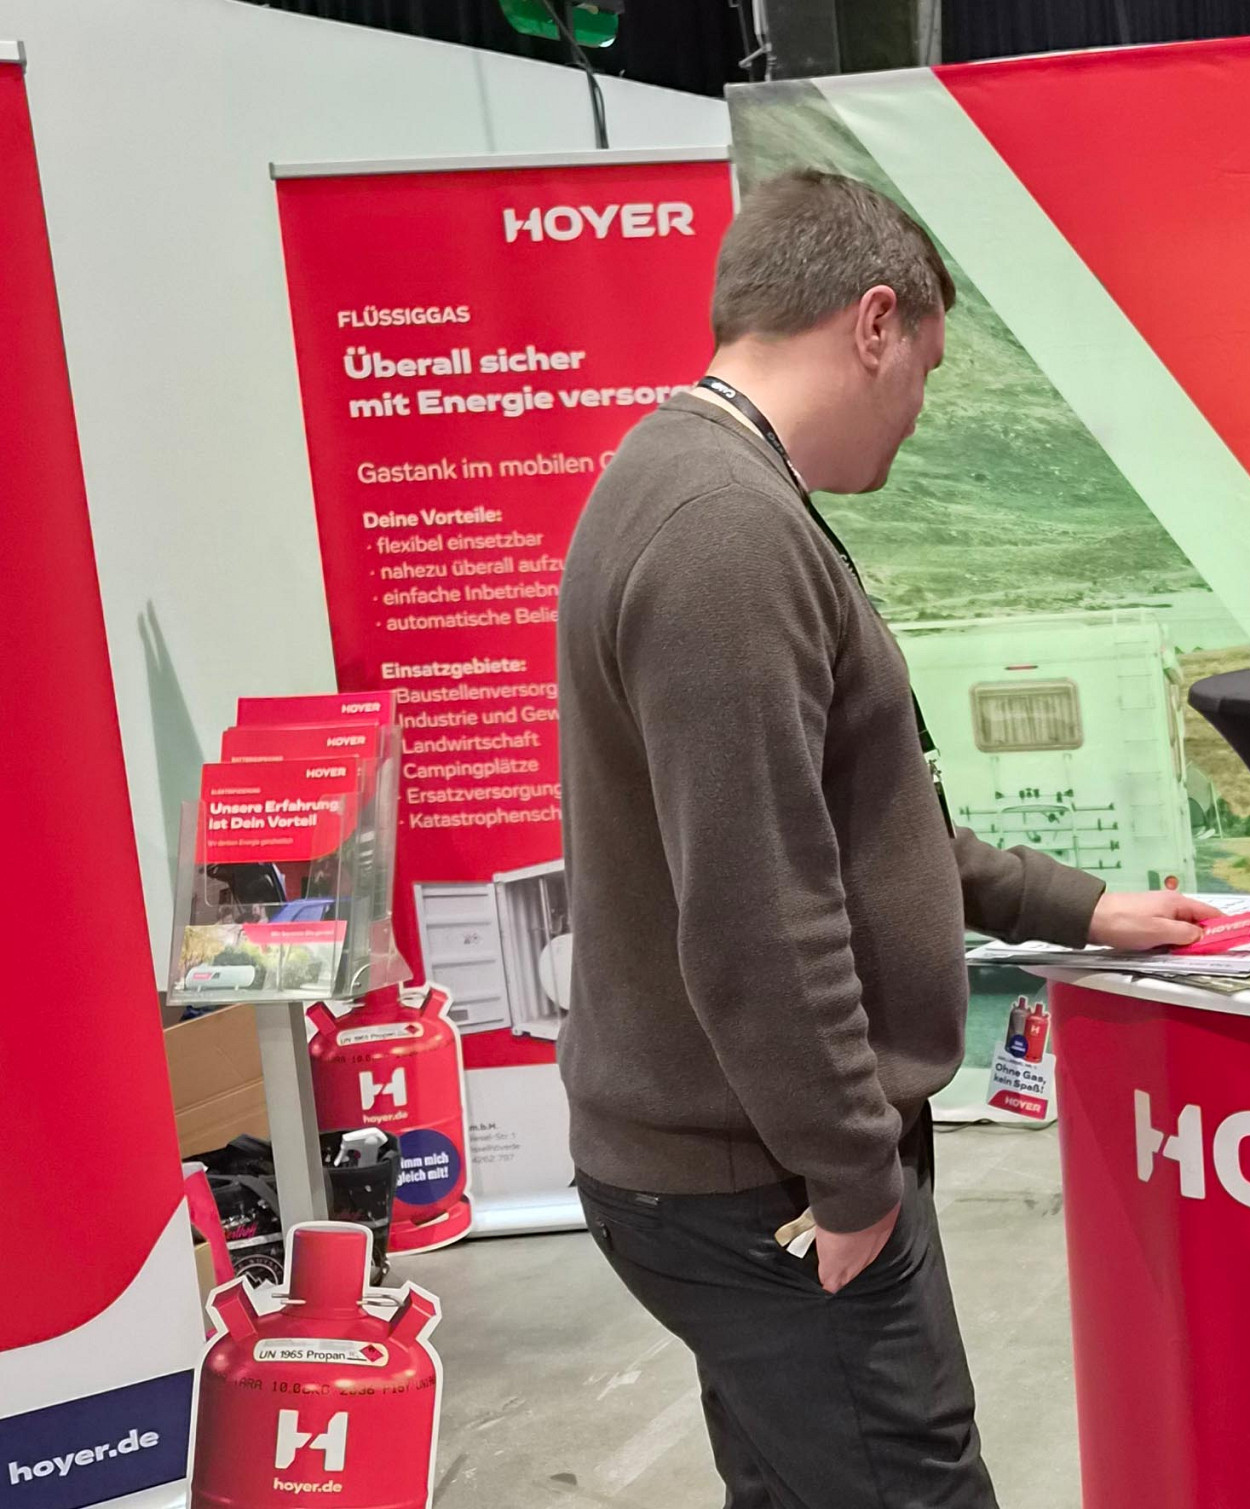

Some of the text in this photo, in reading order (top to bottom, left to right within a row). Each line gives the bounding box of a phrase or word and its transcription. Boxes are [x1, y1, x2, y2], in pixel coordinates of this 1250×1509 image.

[504, 202, 695, 243] HOYER
[338, 305, 471, 328] FLÜSSIGGAS
[343, 345, 586, 380] Überall sicher
[349, 392, 411, 419] mit
[418, 385, 554, 418] Energie
[357, 458, 458, 484] Gastank
[462, 458, 493, 479] im
[500, 453, 595, 478] mobilen
[363, 506, 503, 529] Deine Vorteile:
[377, 531, 543, 555] flexibel einsetzbar
[380, 562, 447, 580] nahezu
[452, 557, 514, 577] überall
[383, 585, 461, 606] einfache
[386, 610, 511, 631] automatische
[381, 658, 527, 680] Einsatzgebiete:
[399, 710, 479, 729] Industrie
[482, 708, 517, 725] und
[402, 731, 541, 755] Landwirtschaft
[306, 767, 346, 778] HOYER
[403, 758, 540, 781] Campingplätze
[210, 798, 340, 815] Unsere Erfahrung
[995, 1063, 1020, 1078] Ohne
[363, 1110, 408, 1124] hoyer.de
[259, 1350, 346, 1362] UN 1965 Propan
[8, 1428, 160, 1486] hoyer.de
[273, 1476, 343, 1494] hoyer.de
